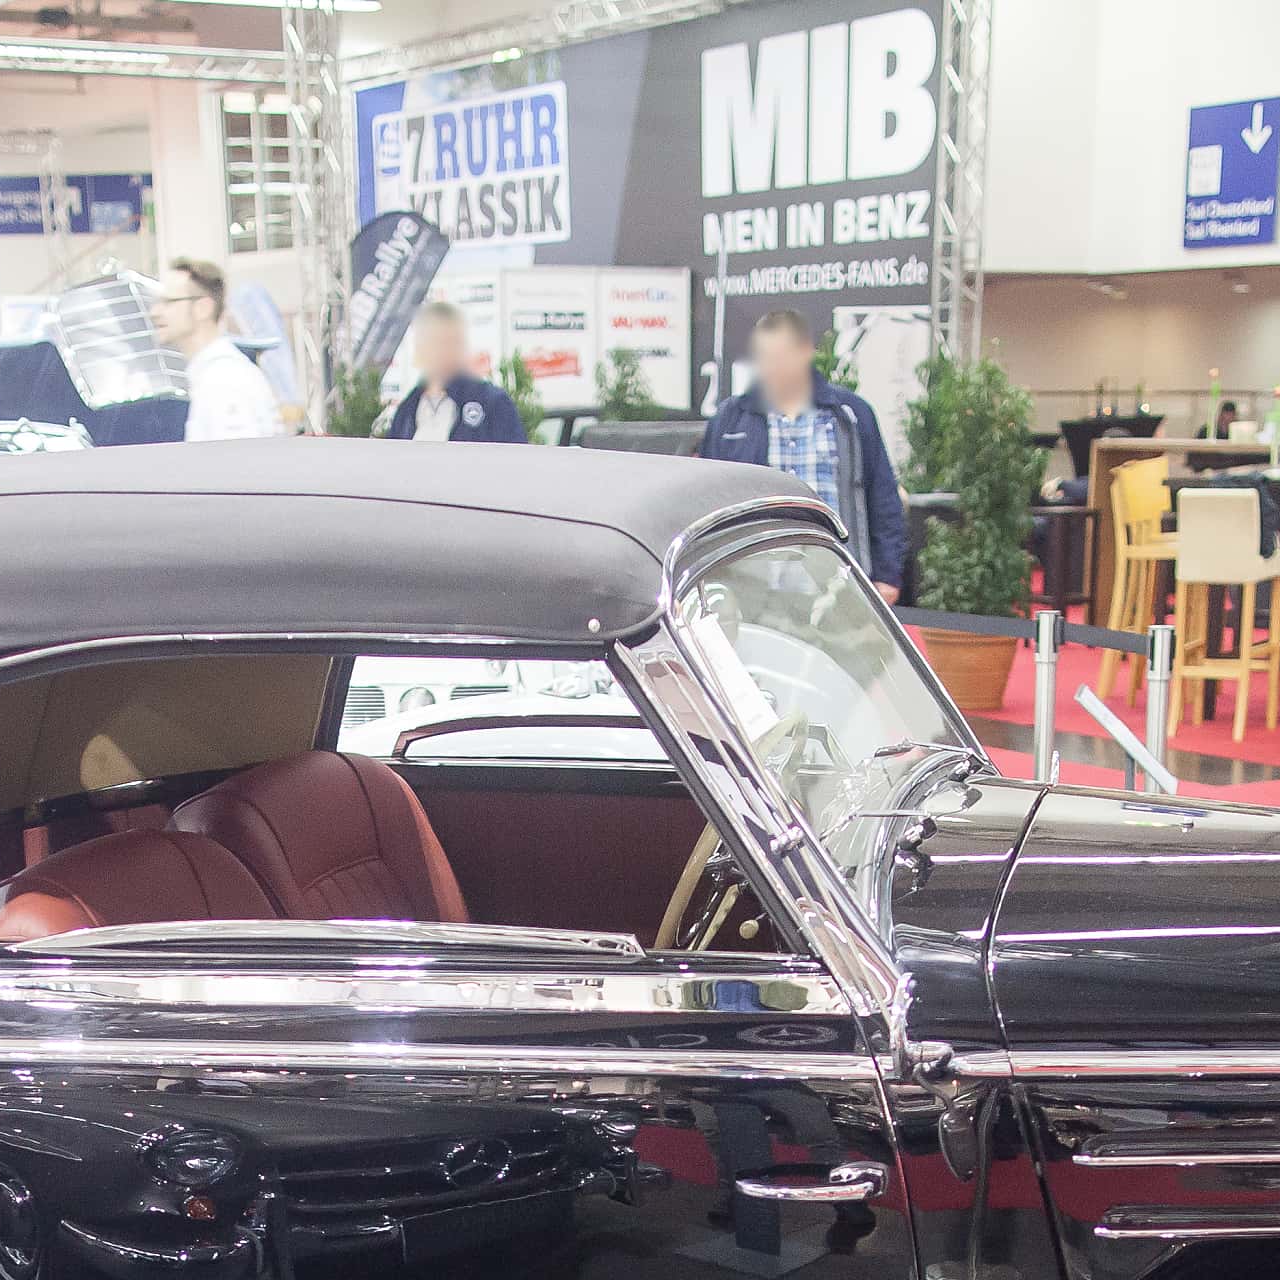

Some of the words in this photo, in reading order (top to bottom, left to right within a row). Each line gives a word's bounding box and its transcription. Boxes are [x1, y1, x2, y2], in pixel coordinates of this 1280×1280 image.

[433, 93, 560, 180] RUHR
[701, 8, 937, 197] MIB
[702, 205, 779, 256] MEN
[786, 201, 825, 248] IN
[832, 189, 931, 245] BENZ
